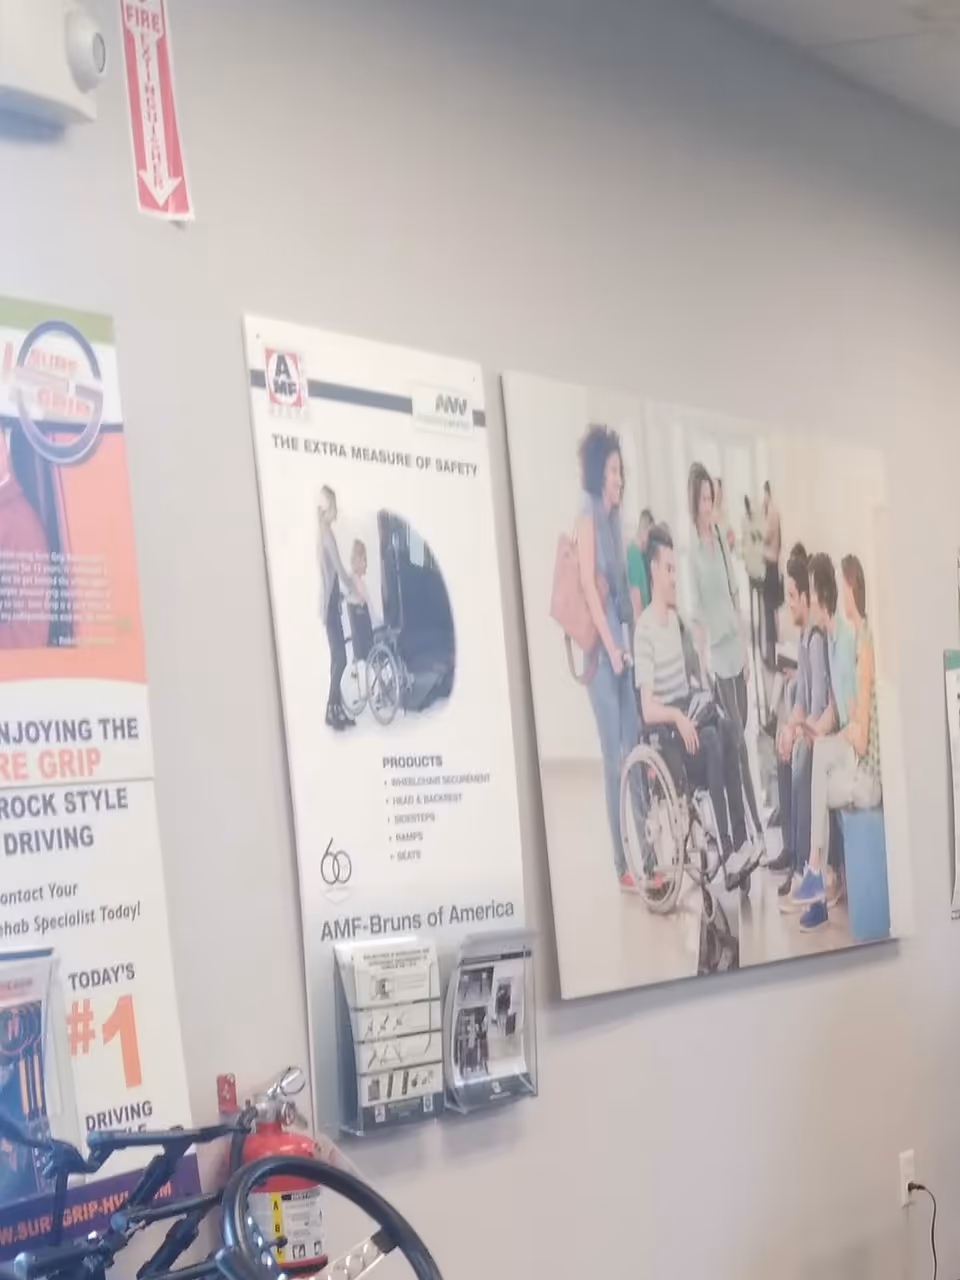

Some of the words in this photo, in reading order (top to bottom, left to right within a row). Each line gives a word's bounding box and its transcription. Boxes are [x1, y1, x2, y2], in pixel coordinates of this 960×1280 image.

[125, 5, 161, 34] FIRE
[271, 433, 300, 451] THE
[303, 438, 347, 459] EXTRA
[350, 446, 412, 469] MEASURE
[415, 455, 432, 471] OF
[434, 458, 478, 478] SAFETY
[98, 716, 139, 741] THE
[37, 746, 102, 780] GRIP
[382, 754, 443, 769] PRODUCTS
[63, 786, 129, 814] STYLE
[3, 825, 94, 856] DRIVING
[48, 882, 79, 899] Your
[33, 909, 96, 936] Specialist
[98, 899, 142, 922] Today!
[319, 911, 422, 942] AMF-Bruns
[426, 905, 445, 929] of
[447, 899, 515, 926] America
[67, 962, 136, 991] TODAY'S
[65, 992, 143, 1090] #1
[85, 1099, 153, 1132] DRIVING
